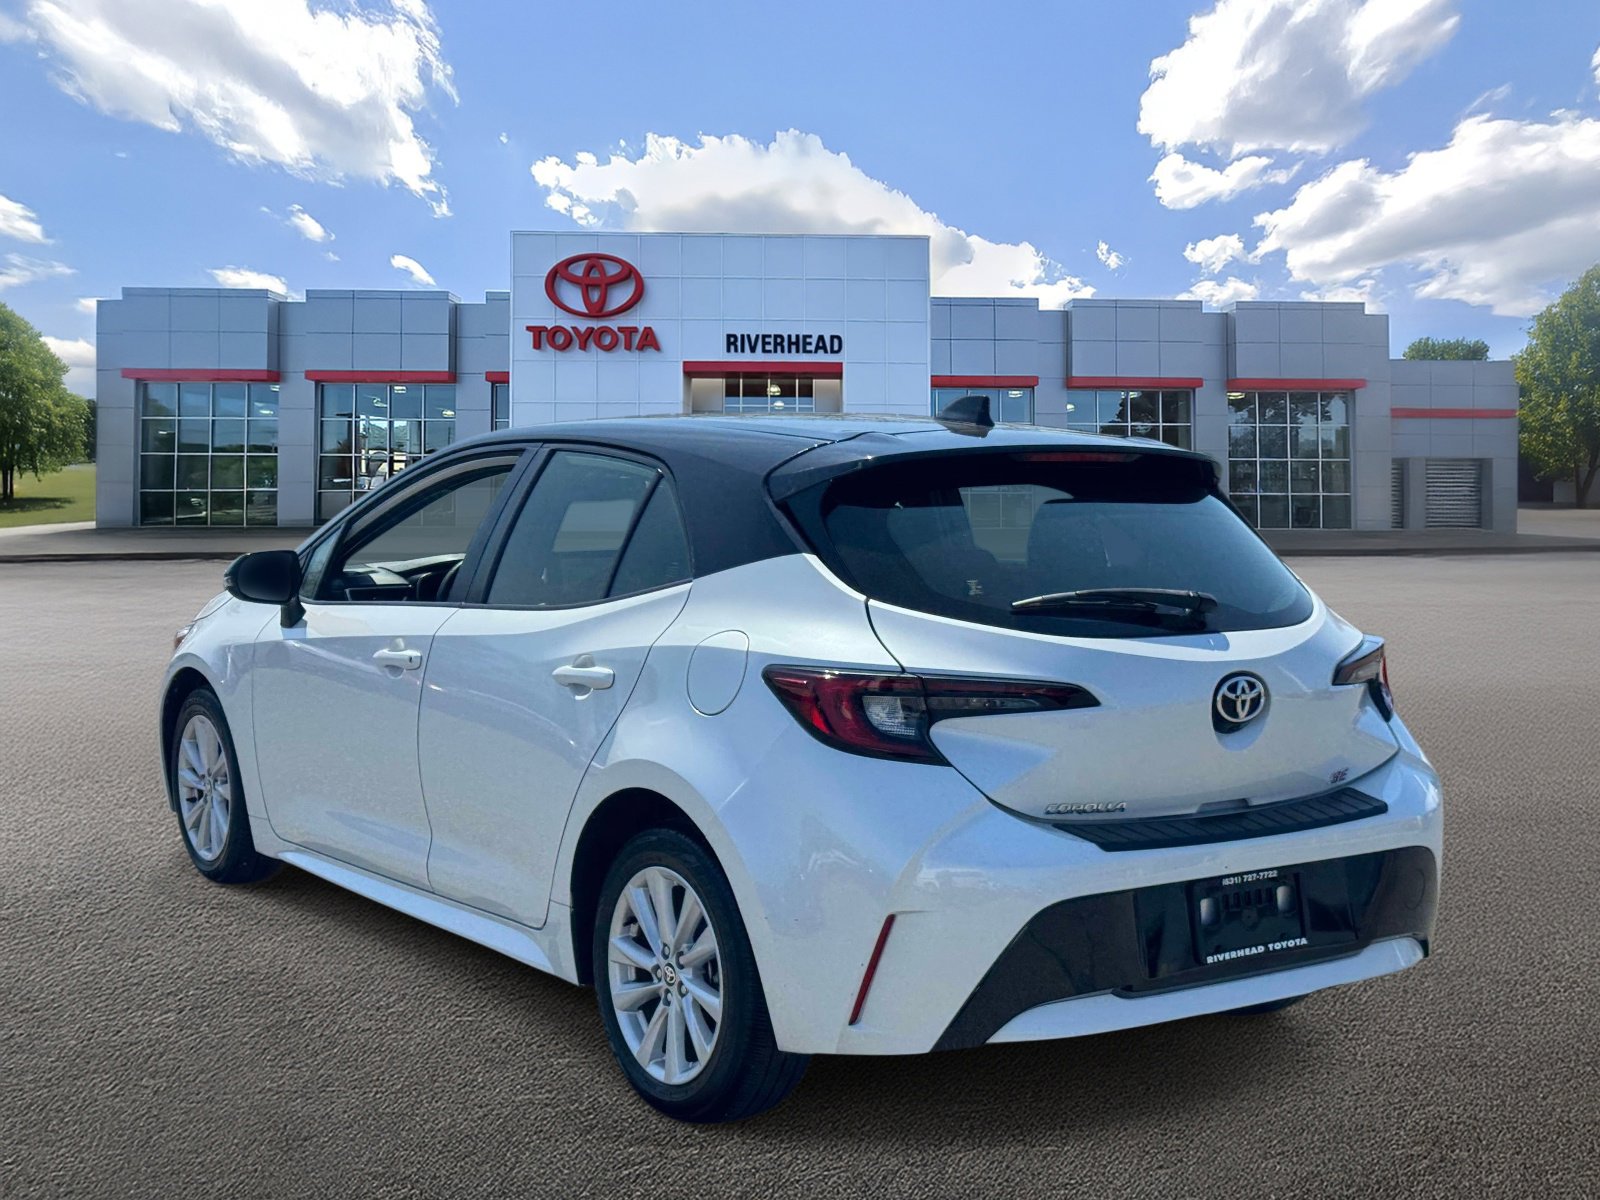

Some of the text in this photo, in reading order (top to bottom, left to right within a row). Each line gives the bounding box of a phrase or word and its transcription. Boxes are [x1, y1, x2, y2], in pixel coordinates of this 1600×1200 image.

[526, 326, 661, 352] TOYOTA
[726, 334, 843, 354] RIVERHEAD
[1044, 801, 1127, 815] COROLLA
[1243, 870, 1278, 883] 727-7722
[1206, 937, 1308, 964] RIVERHEAD TOYOTA
